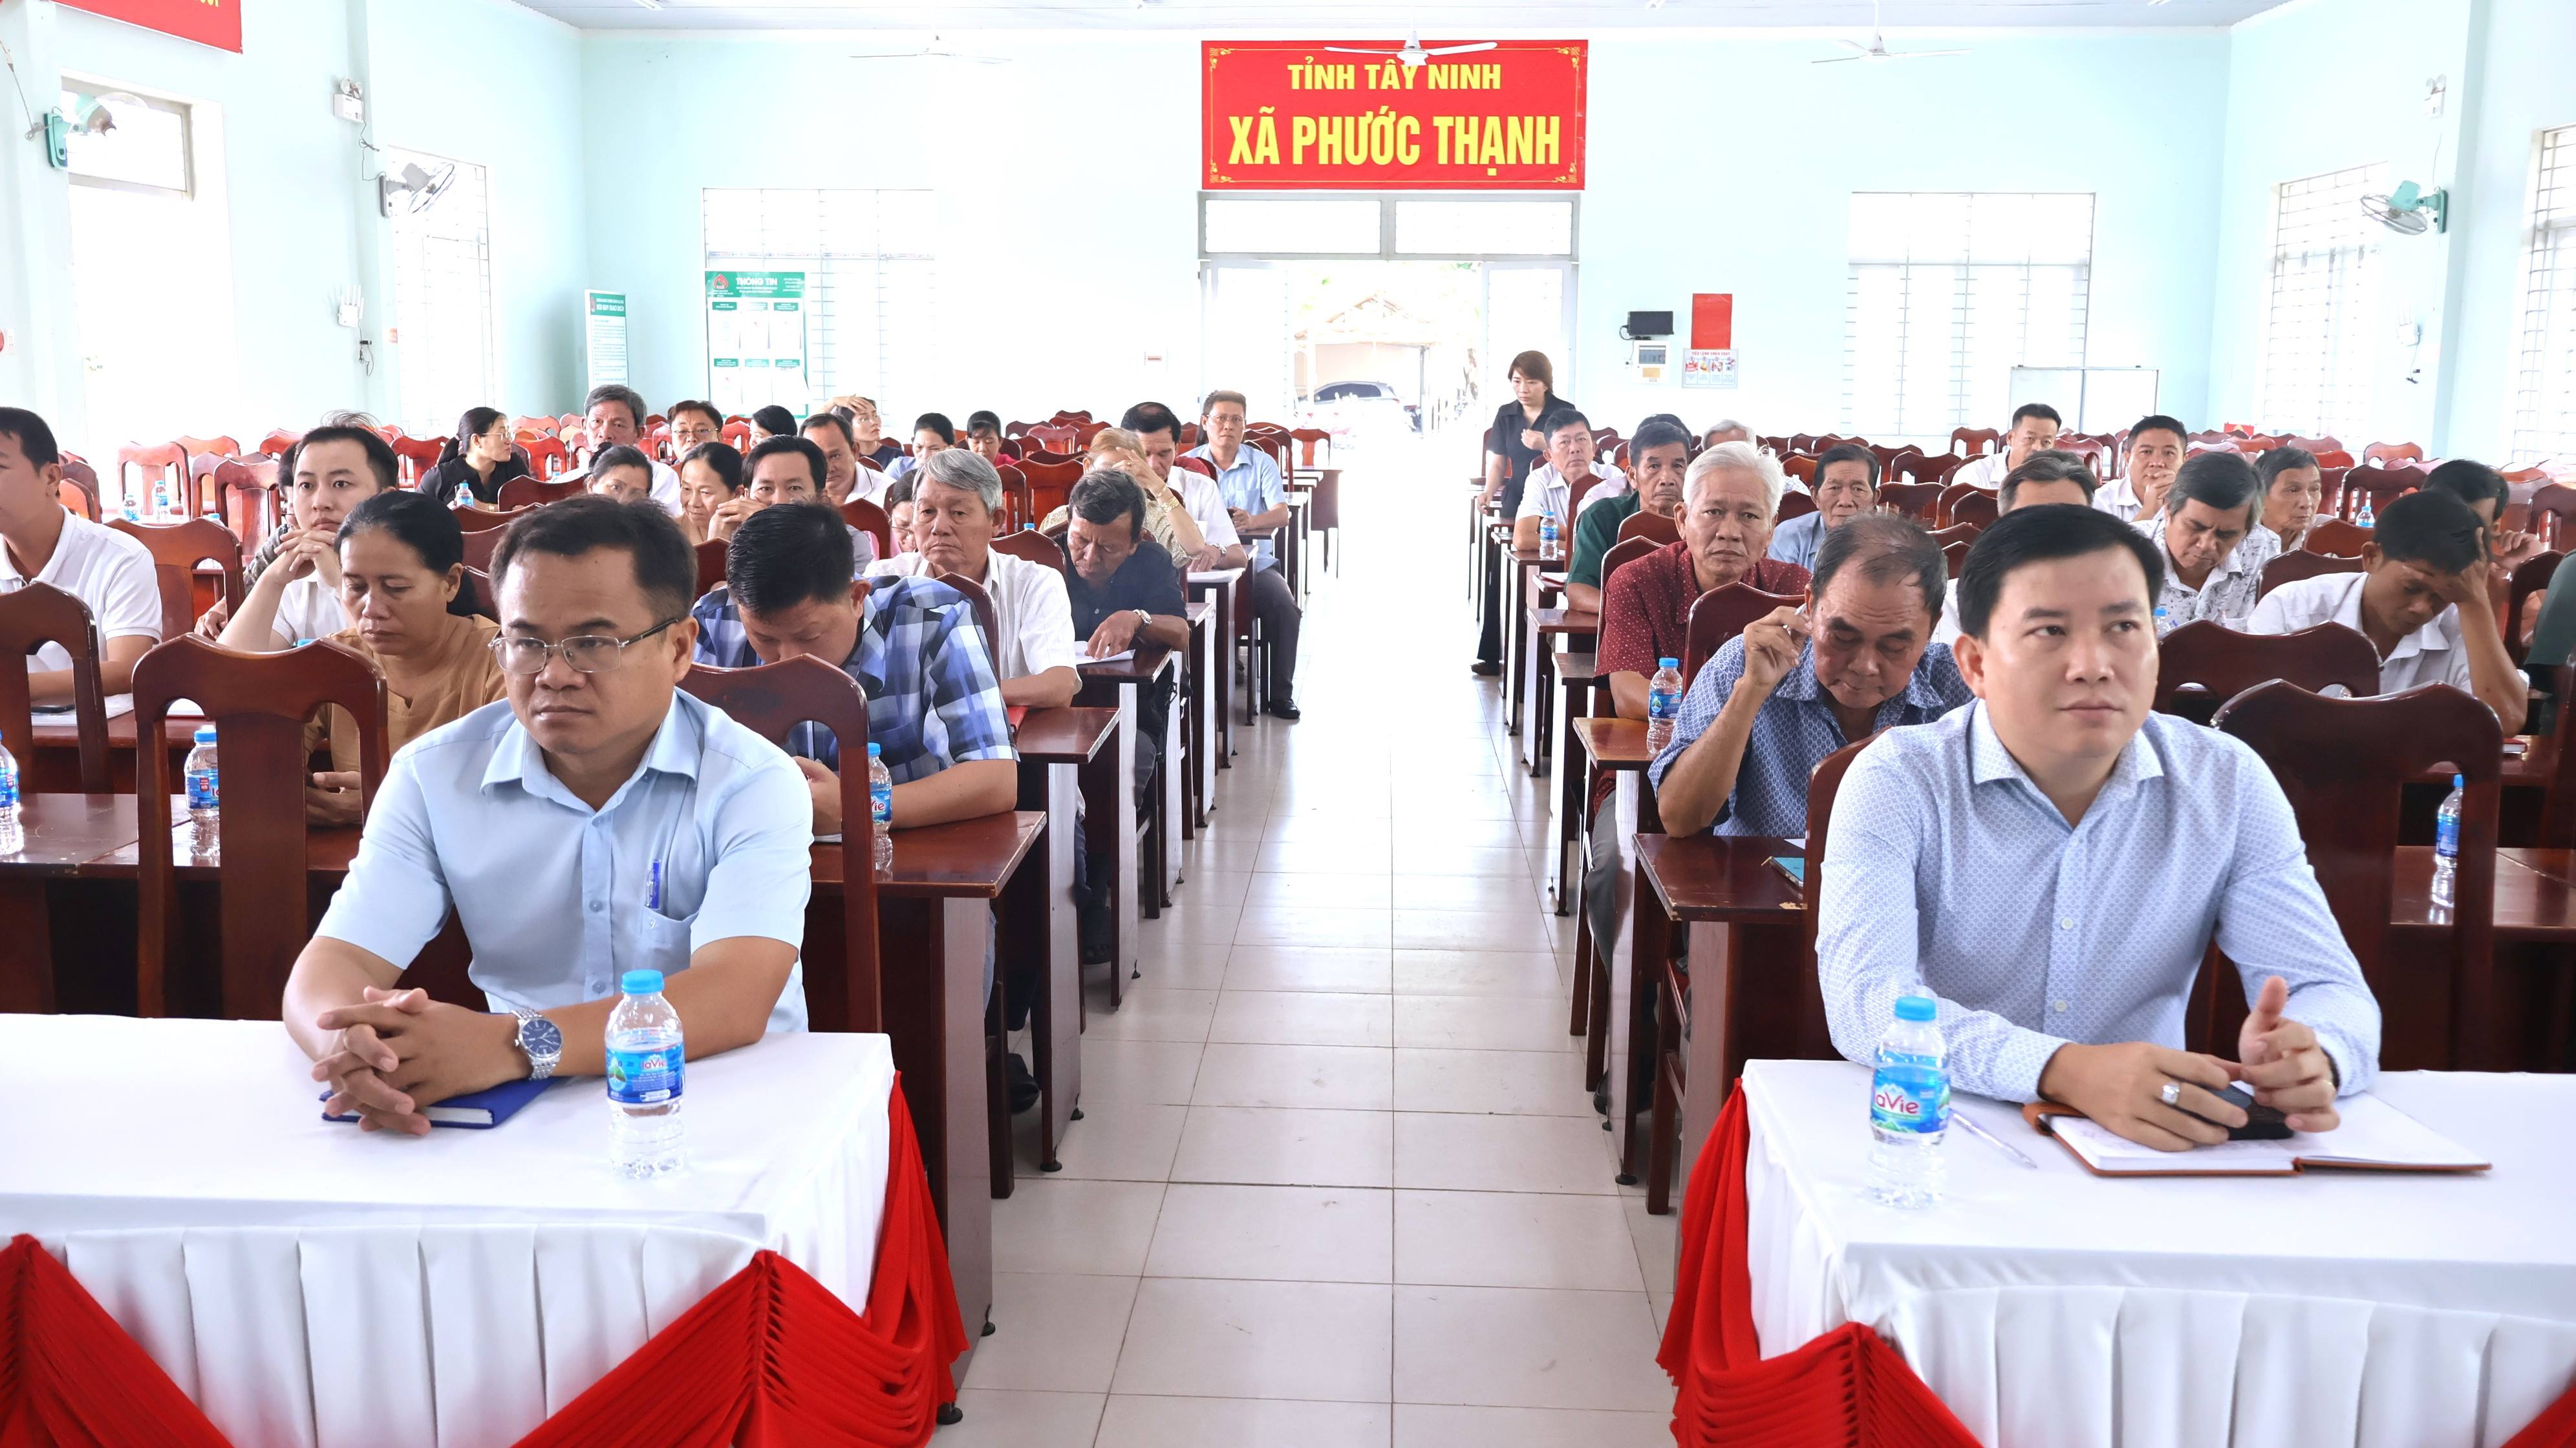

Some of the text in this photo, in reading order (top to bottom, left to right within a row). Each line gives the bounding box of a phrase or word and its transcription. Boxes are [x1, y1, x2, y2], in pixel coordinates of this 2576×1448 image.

[1288, 56, 1501, 90] TỈNH TÂY NINH
[1229, 106, 1560, 176] XÃ PHƯỚC THẠNH
[1876, 1091, 1919, 1114] aVie
